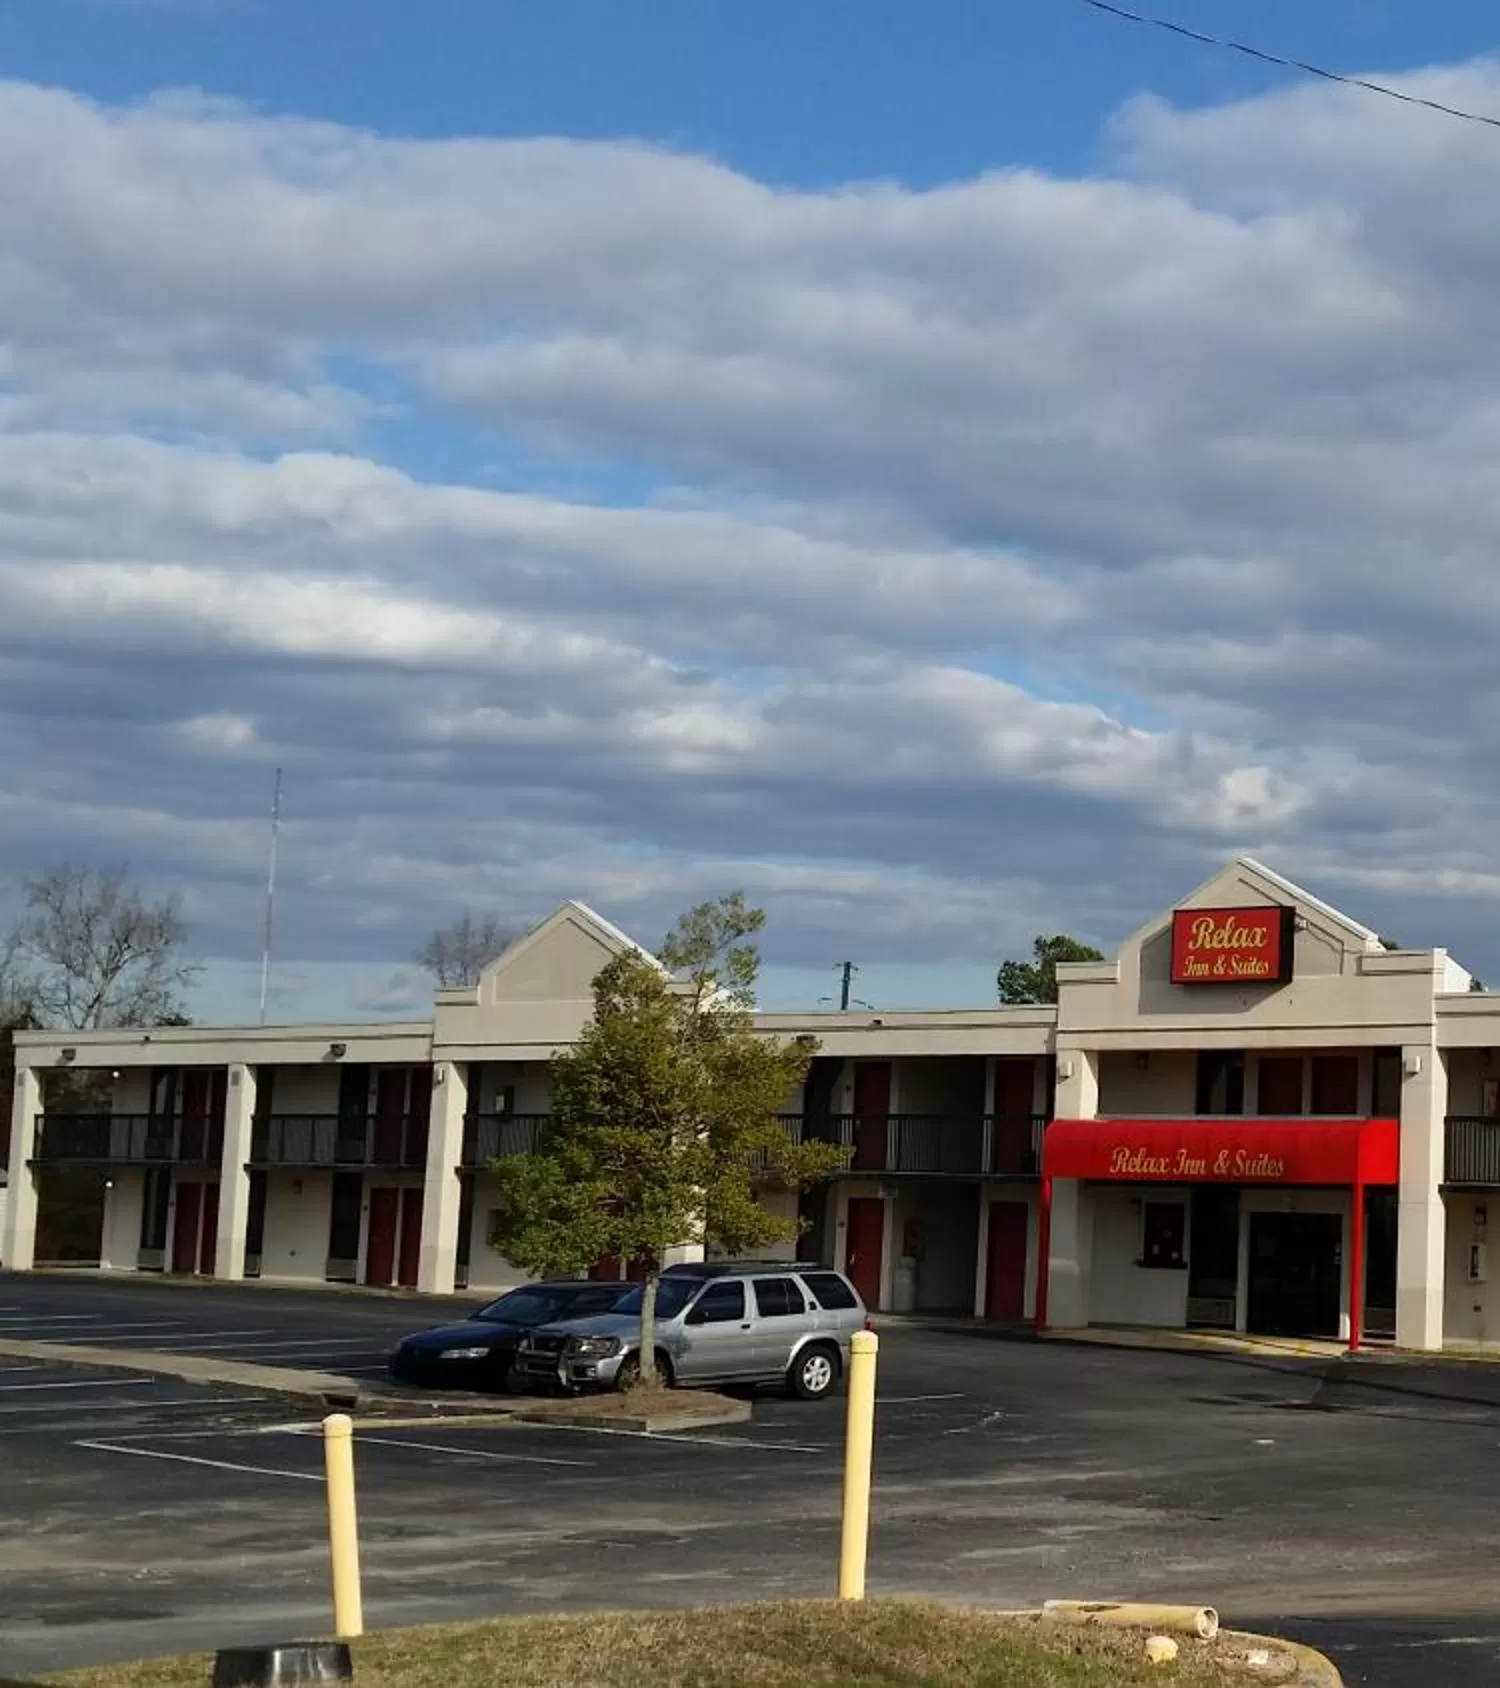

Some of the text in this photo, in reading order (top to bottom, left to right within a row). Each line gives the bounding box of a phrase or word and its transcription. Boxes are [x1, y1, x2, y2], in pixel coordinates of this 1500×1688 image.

[1188, 916, 1268, 949] Relax
[1183, 953, 1269, 977] Inn & Suites
[1109, 1146, 1284, 1177] Relax Inn & Suites
